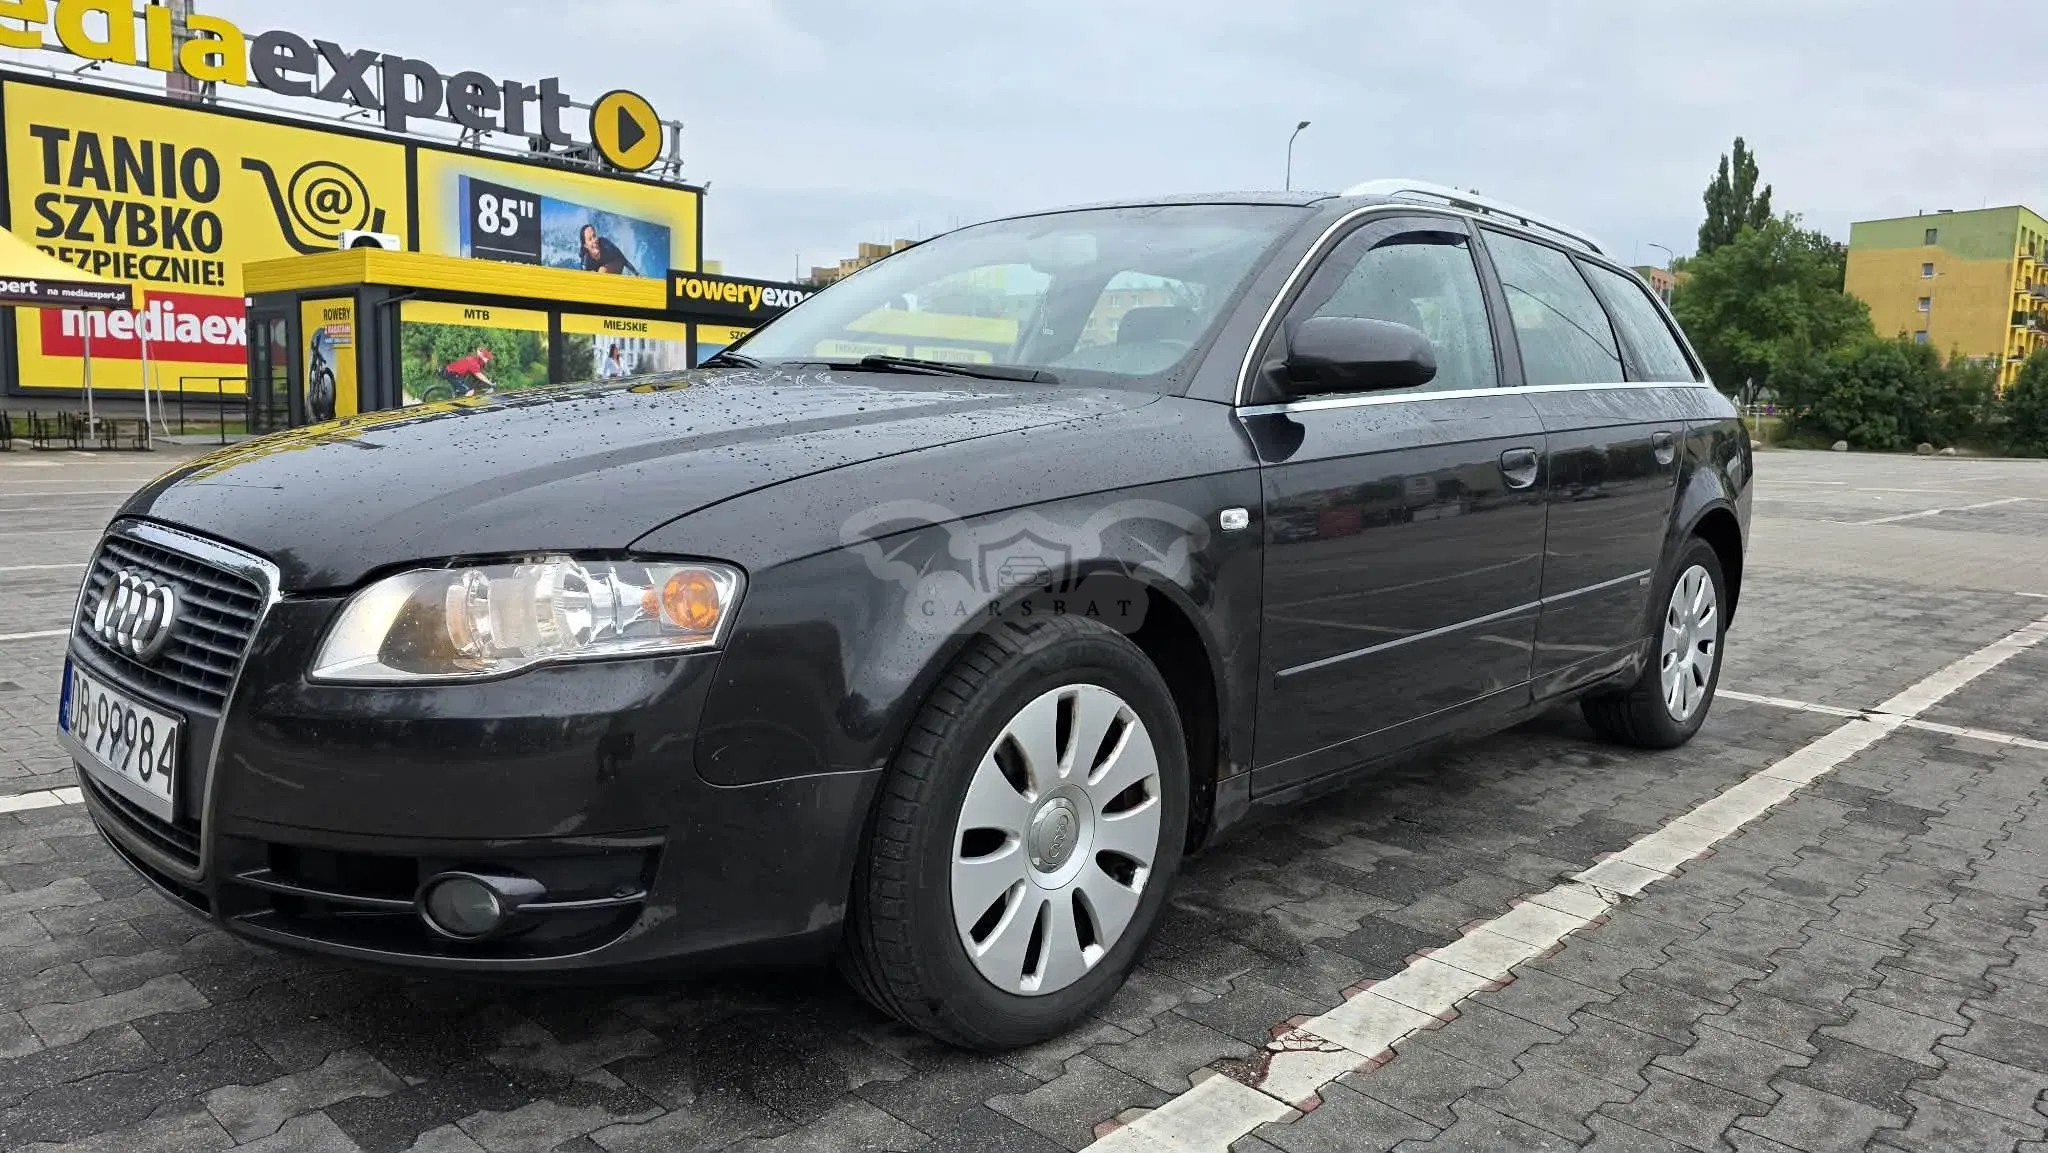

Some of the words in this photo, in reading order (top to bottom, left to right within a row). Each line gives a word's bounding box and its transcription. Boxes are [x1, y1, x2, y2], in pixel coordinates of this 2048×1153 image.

[29, 123, 221, 203] TANIO
[34, 192, 223, 254] SZYBKO
[477, 193, 535, 237] 85"
[46, 288, 59, 296] na
[61, 288, 126, 302] mediaexpert.pl
[323, 307, 351, 321] ROWERY
[463, 308, 490, 321] MTB
[603, 319, 648, 333] MIEJSKIE
[71, 670, 90, 742] DB
[96, 691, 177, 795] 99984
